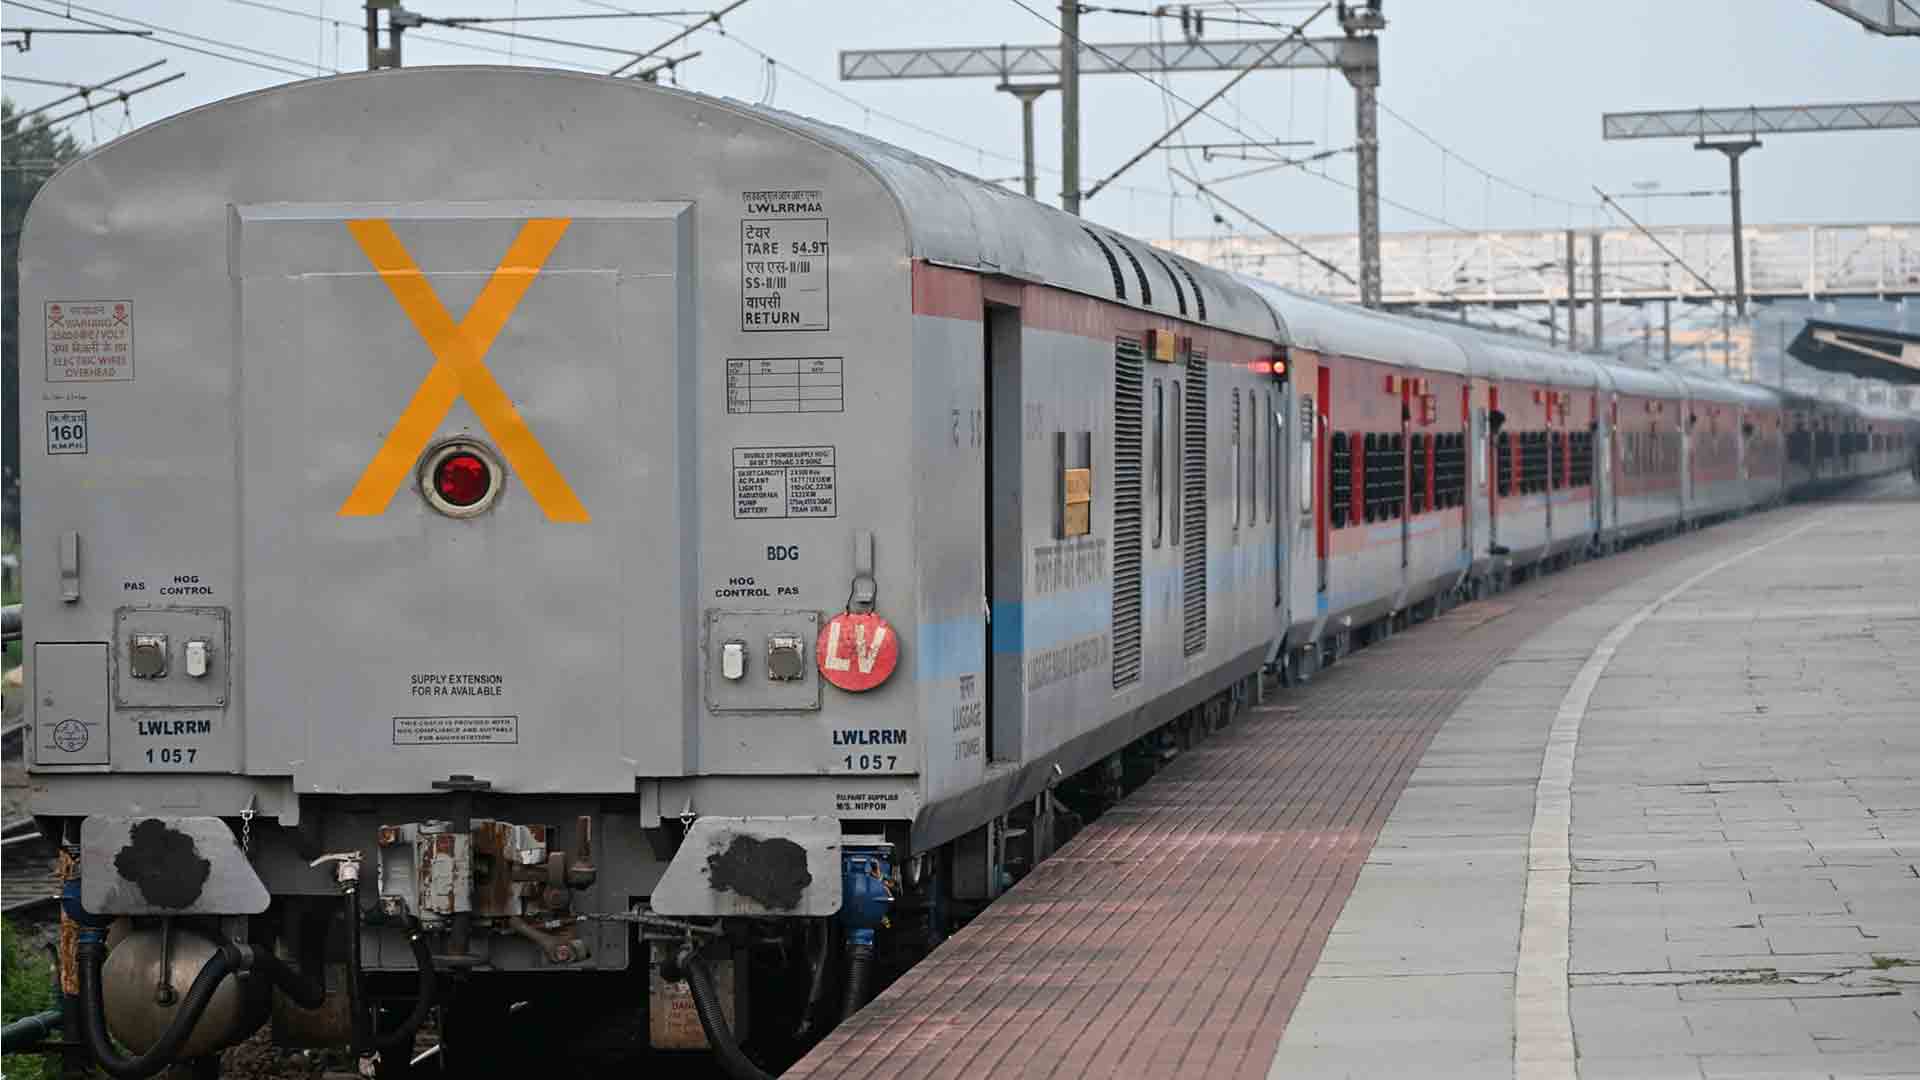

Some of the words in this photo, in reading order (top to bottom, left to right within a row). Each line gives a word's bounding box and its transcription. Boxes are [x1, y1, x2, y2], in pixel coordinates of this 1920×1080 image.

[748, 203, 823, 214] LWLRRMAA
[745, 242, 779, 255] TARE
[792, 241, 828, 254] 54.9T
[745, 277, 787, 289] SS-II/III
[745, 291, 781, 309] वापसी
[745, 312, 800, 325] RETURN
[65, 368, 115, 377] OVERHEAD
[336, 218, 592, 523] X
[51, 424, 84, 441] 160
[767, 545, 800, 561] BDG
[173, 575, 199, 583] HOG
[729, 577, 755, 586] HOG
[124, 582, 145, 591] PAS
[159, 586, 214, 595] CONTROL
[715, 588, 770, 598] CONTROL
[777, 586, 800, 596] PAS
[824, 622, 887, 674] LV
[410, 674, 447, 685] SUPPLY
[449, 674, 503, 685] EXTENSION
[411, 686, 432, 696] FOR
[434, 686, 448, 696] RA
[451, 686, 503, 696] AVAILABLE
[138, 720, 211, 736] LWLRRM
[832, 729, 908, 745] LWLRRM
[855, 802, 887, 810] NIPPON
